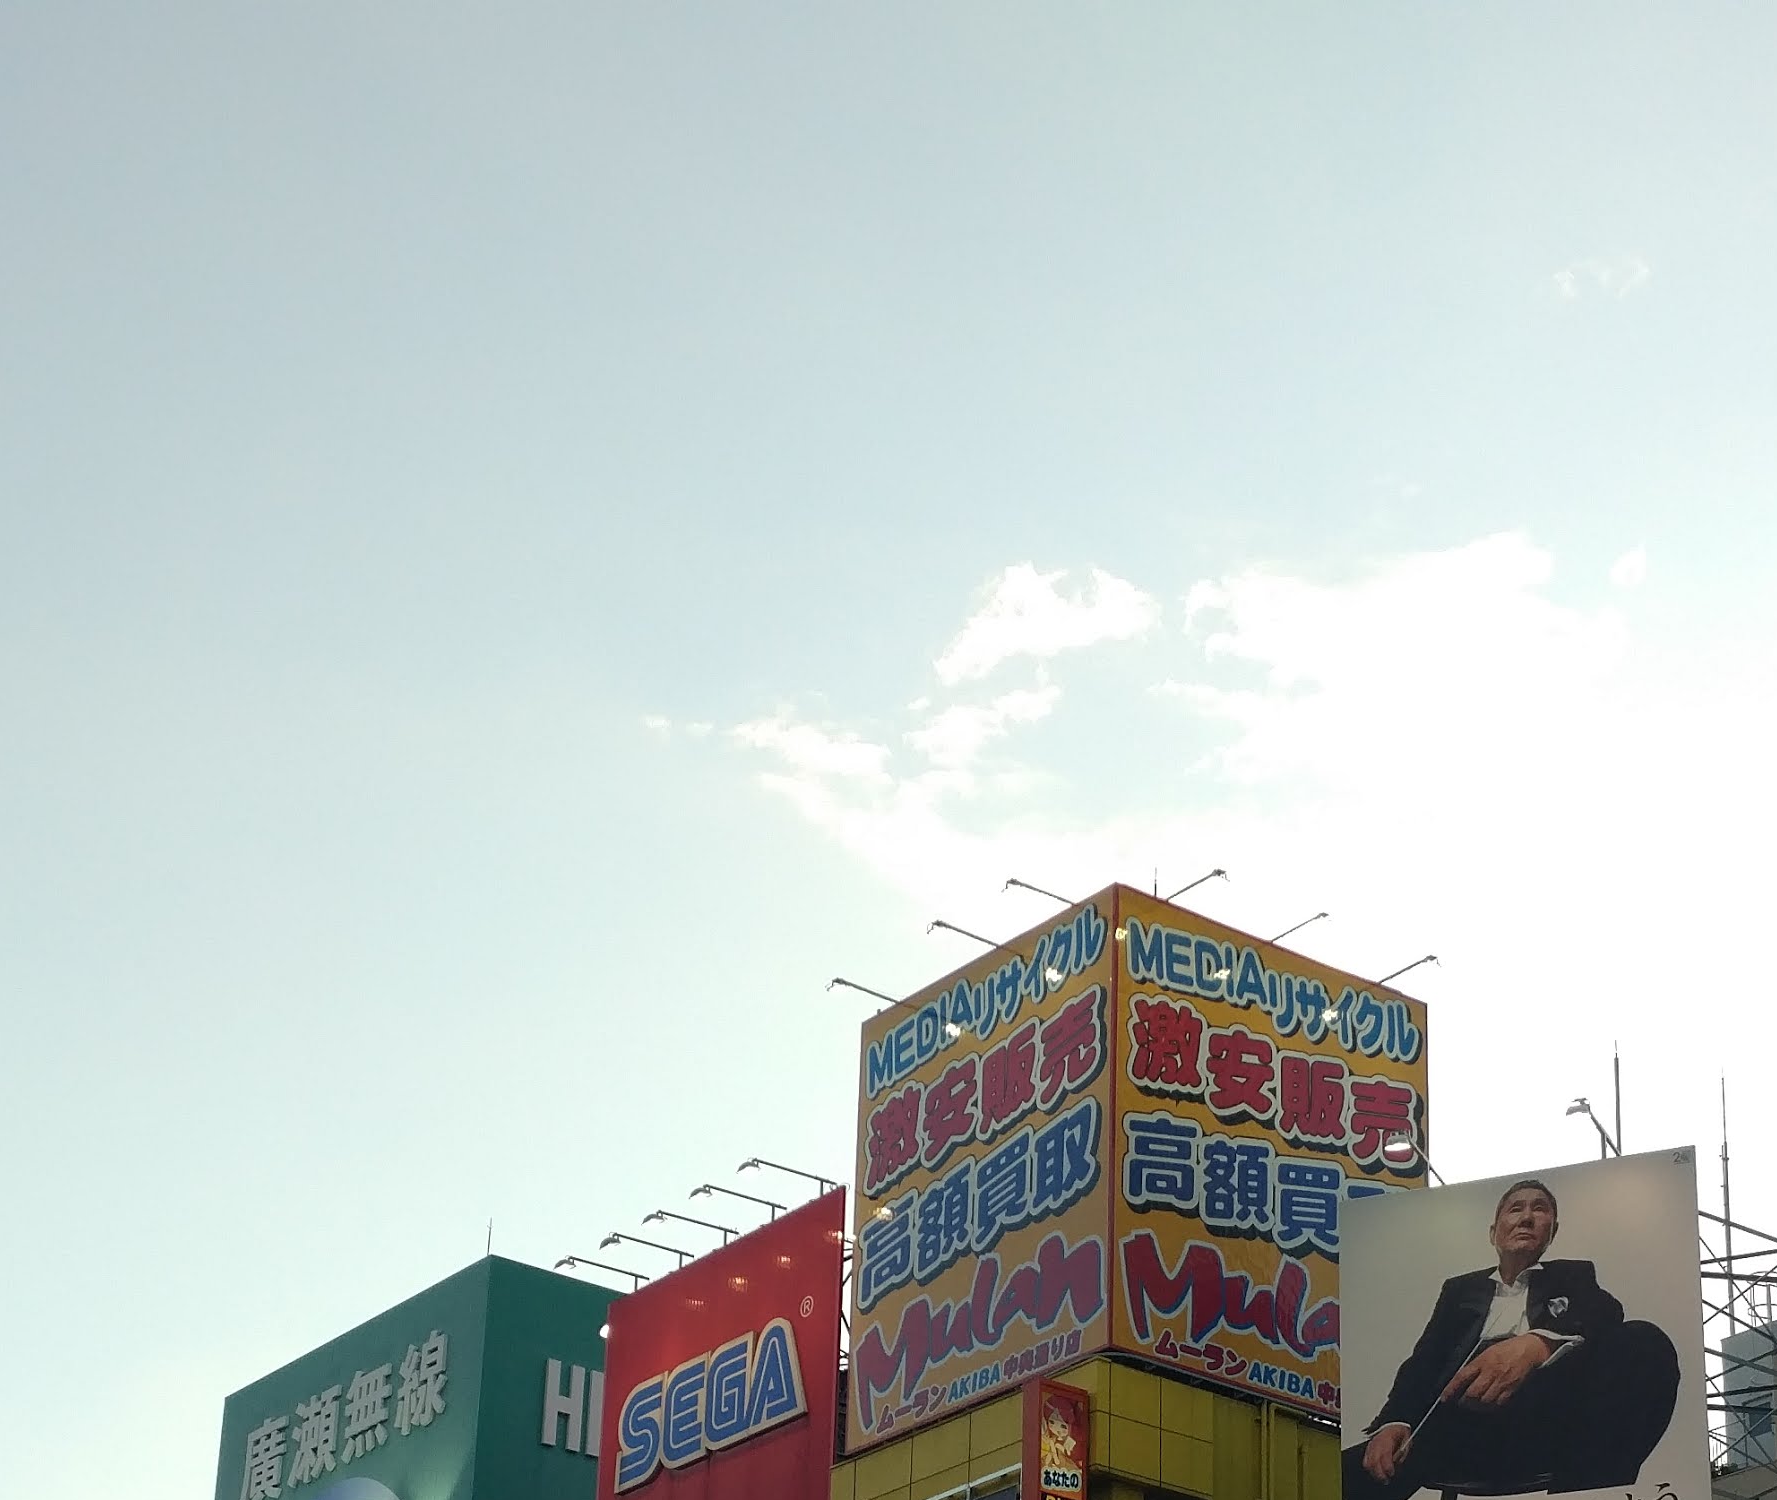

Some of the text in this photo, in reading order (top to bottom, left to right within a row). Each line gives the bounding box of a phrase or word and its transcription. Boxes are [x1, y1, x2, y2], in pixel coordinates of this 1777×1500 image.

[866, 905, 1107, 1099] MEDIAリサイクル
[1123, 918, 1422, 1064] MEDIAリサイクル
[865, 984, 1107, 1197] 激安販売
[1130, 994, 1420, 1171] 激安販売
[858, 1096, 1102, 1311] 高額買取
[1122, 1111, 1415, 1260] 高額買
[613, 1315, 810, 1496] SEGA
[854, 1232, 1106, 1432] Mulan
[876, 1386, 946, 1434] ムーラン
[947, 1364, 1002, 1403] AKIBA
[1156, 1329, 1247, 1376] ムーラン
[1249, 1361, 1315, 1399] AKIBA
[1042, 1470, 1080, 1490] あなたの
